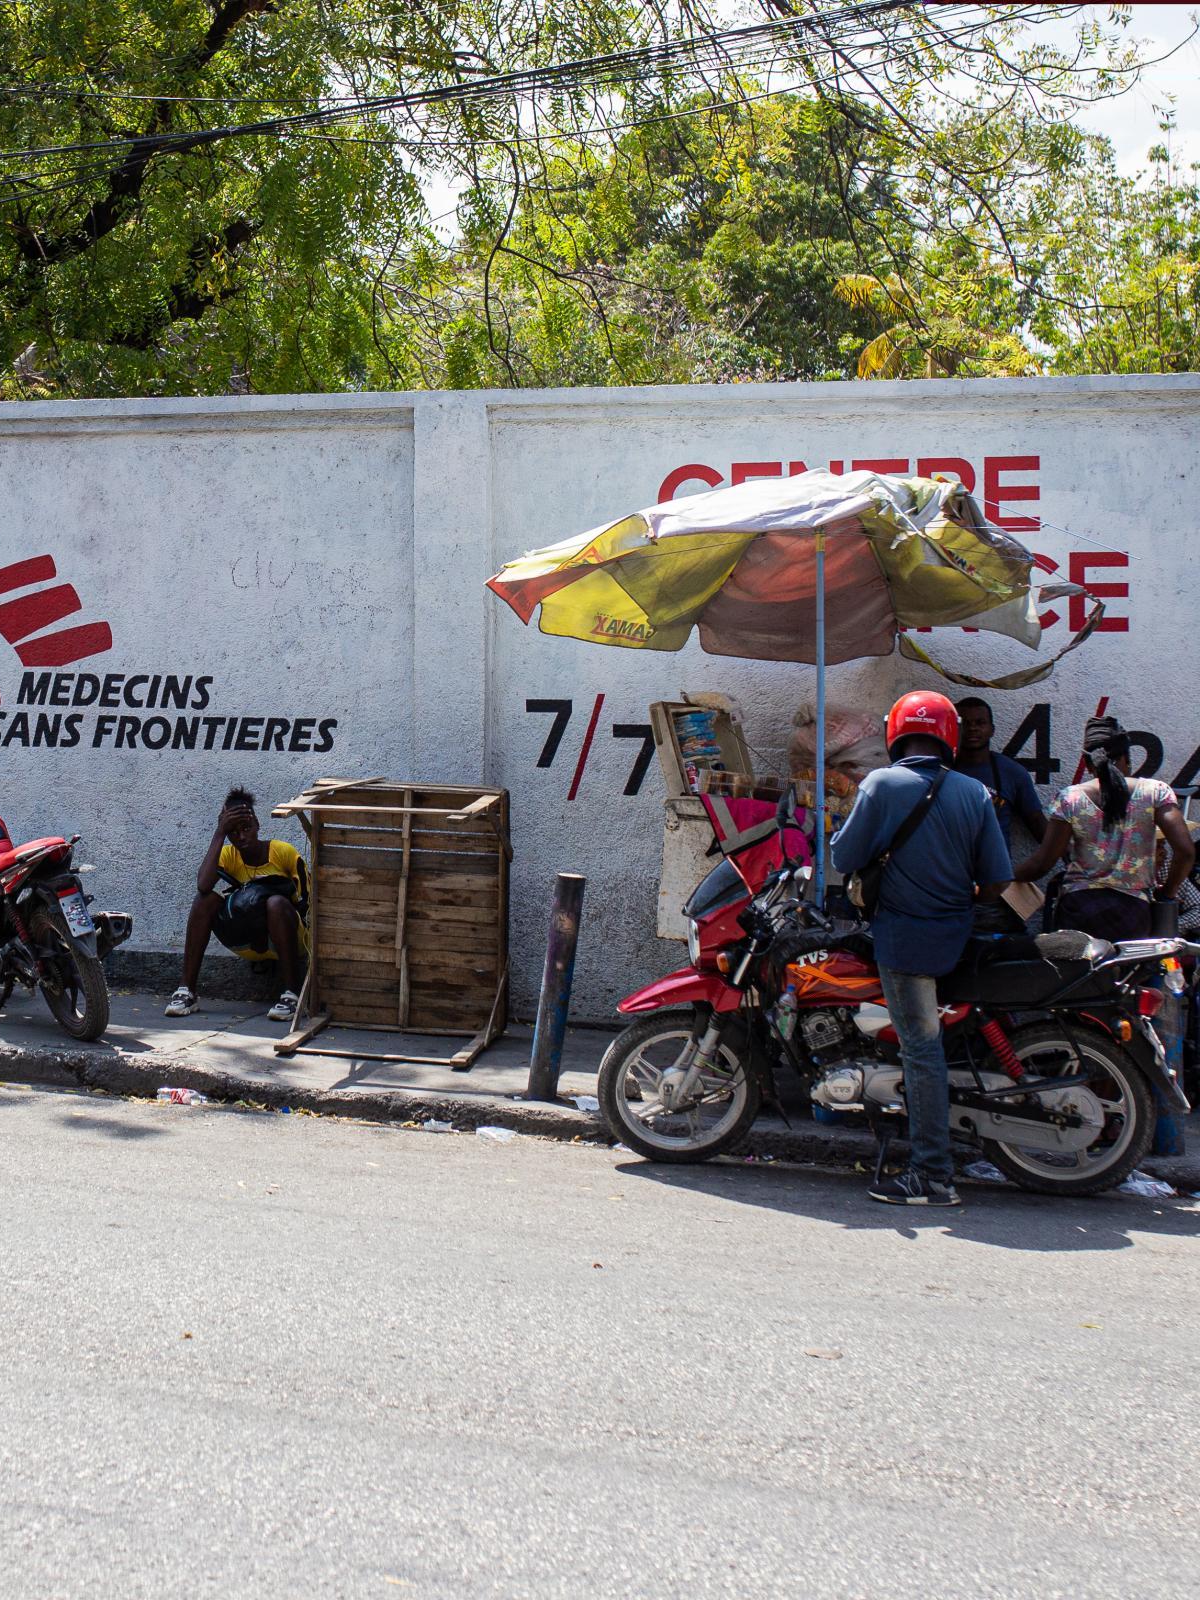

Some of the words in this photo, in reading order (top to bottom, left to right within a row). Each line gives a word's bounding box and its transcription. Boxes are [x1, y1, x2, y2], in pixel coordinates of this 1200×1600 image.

[16, 671, 214, 710] MEDECINS
[92, 715, 339, 753] FRONTIERES
[797, 949, 829, 968] TVS
